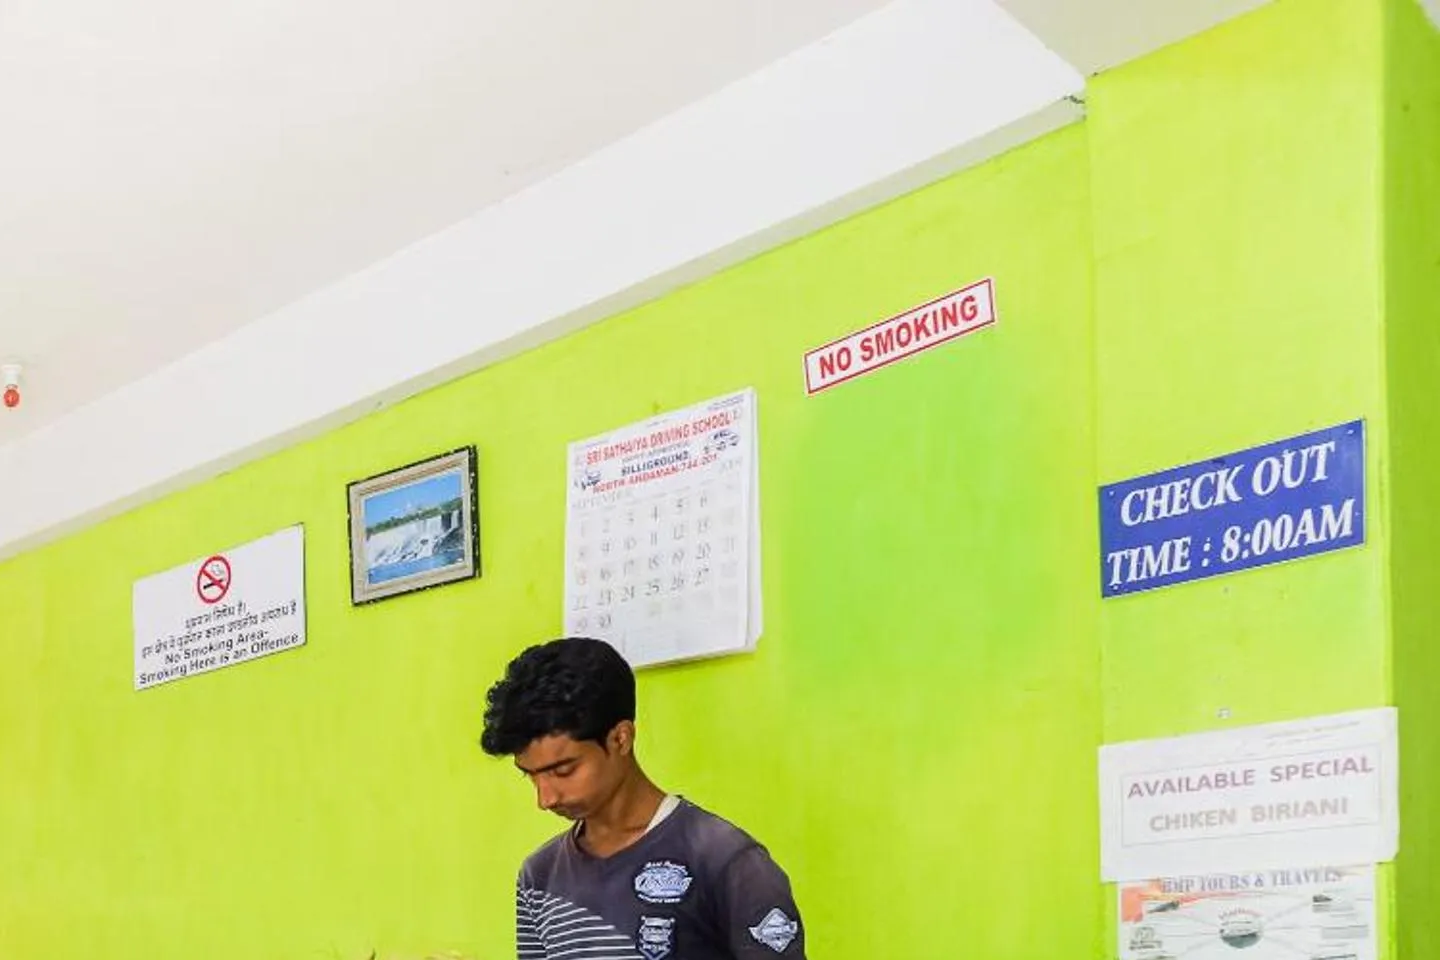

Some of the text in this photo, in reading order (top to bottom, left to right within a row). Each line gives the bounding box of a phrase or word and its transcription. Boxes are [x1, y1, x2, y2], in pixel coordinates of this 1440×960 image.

[818, 295, 978, 379] NO SMOKING
[650, 423, 691, 448] DRIVING
[692, 410, 732, 436] SCHOOL
[1120, 441, 1336, 526] CHECK OUT
[1107, 498, 1356, 586] TIME : 8:00AM
[138, 663, 188, 686] Smoking
[189, 656, 216, 672] Here
[232, 647, 248, 660] an
[250, 631, 300, 655] Offence
[164, 653, 182, 665] No
[183, 637, 234, 661] Smoking
[1127, 755, 1375, 799] AVAILABLE SPECIAL
[1149, 796, 1348, 833] CHIKEN BIRIANI
[1200, 872, 1251, 891] TOURS
[1253, 871, 1265, 888] &
[1271, 865, 1343, 887] TRAVELS
